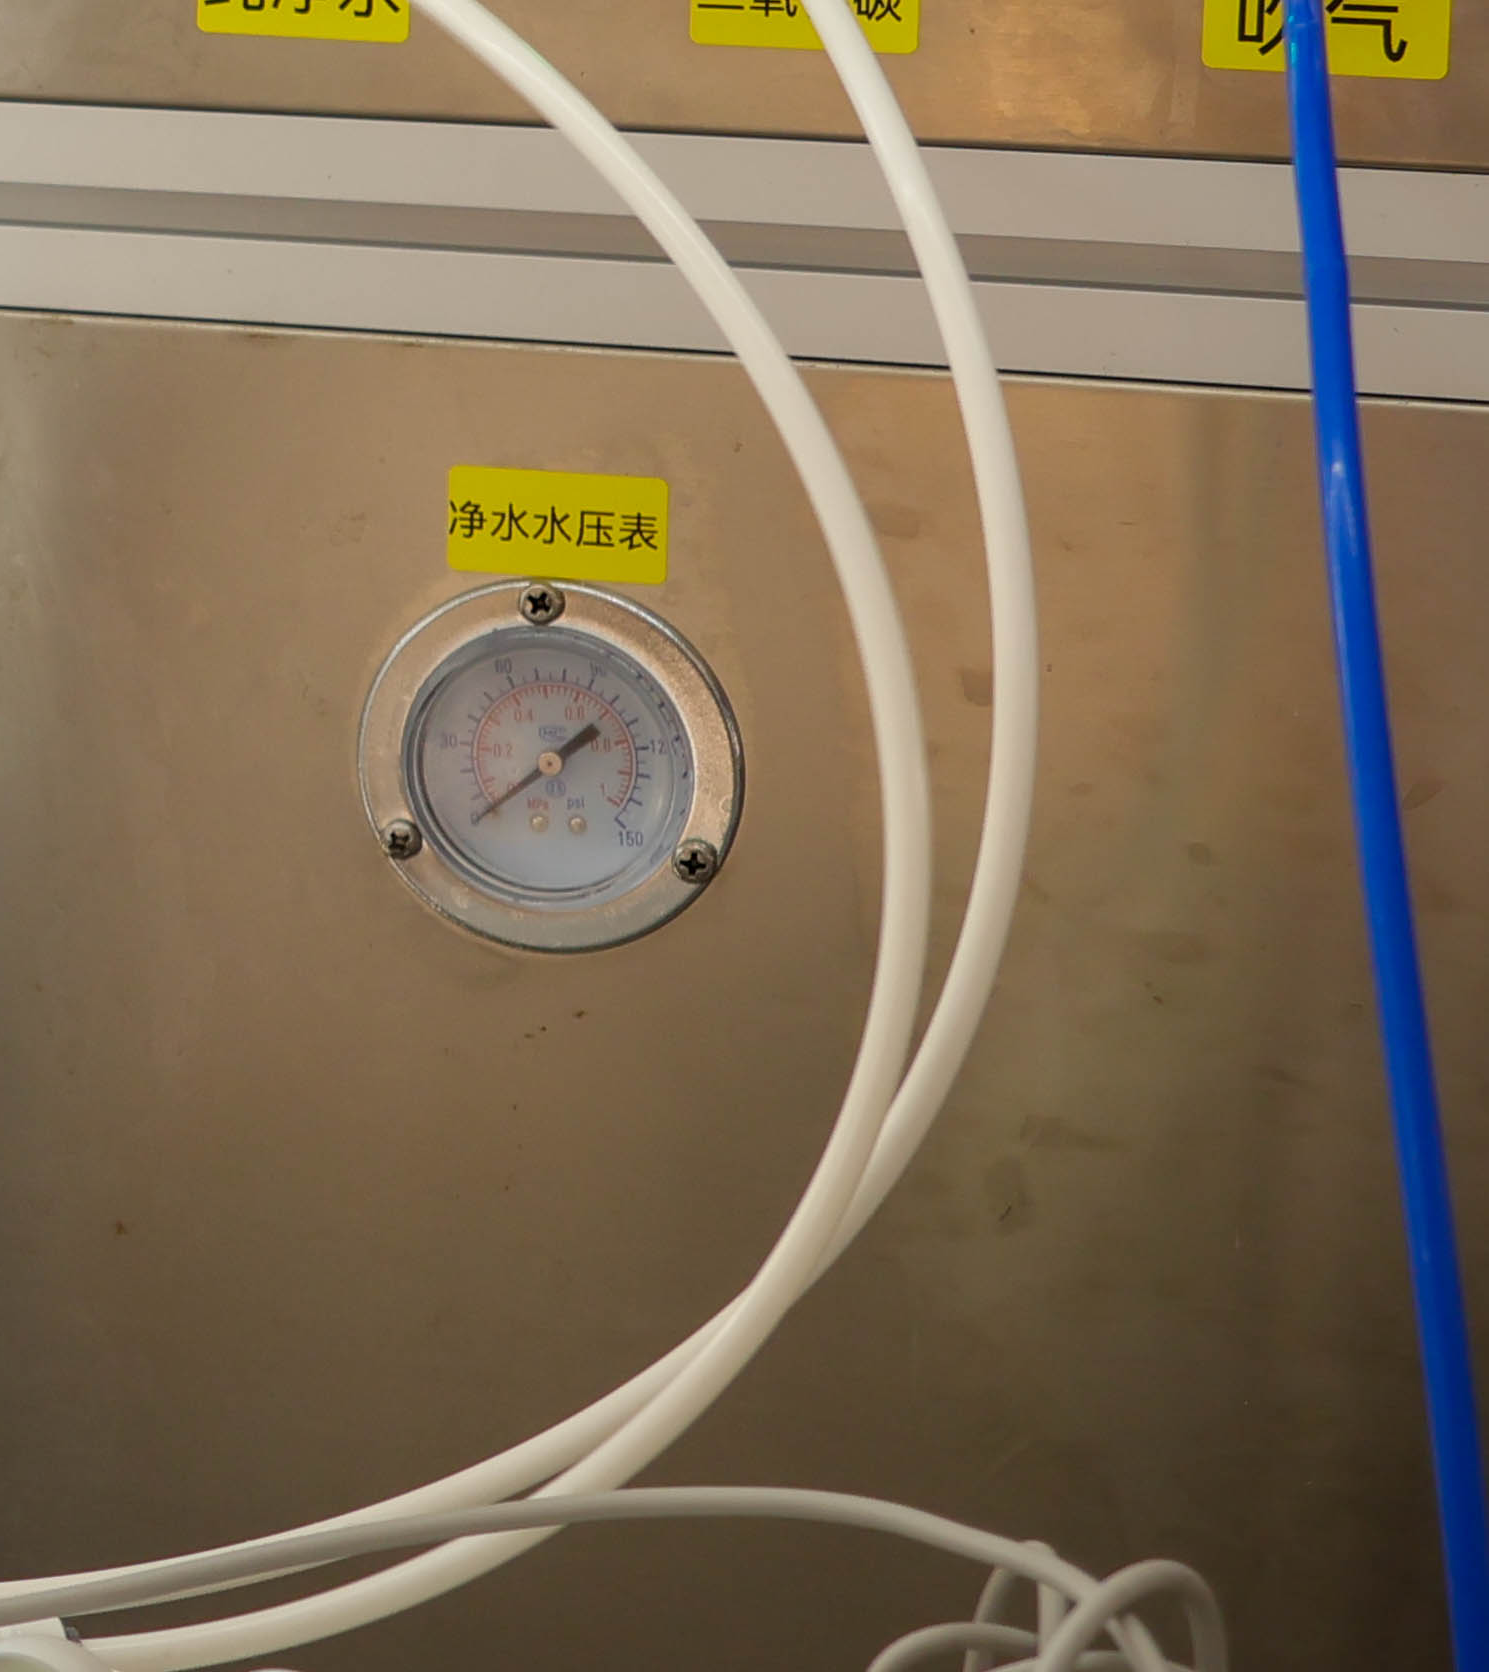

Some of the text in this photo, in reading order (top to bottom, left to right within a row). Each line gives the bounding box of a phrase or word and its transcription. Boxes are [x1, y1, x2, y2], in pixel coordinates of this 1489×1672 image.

[447, 499, 659, 552] 净水水压表
[617, 831, 644, 847] 150
